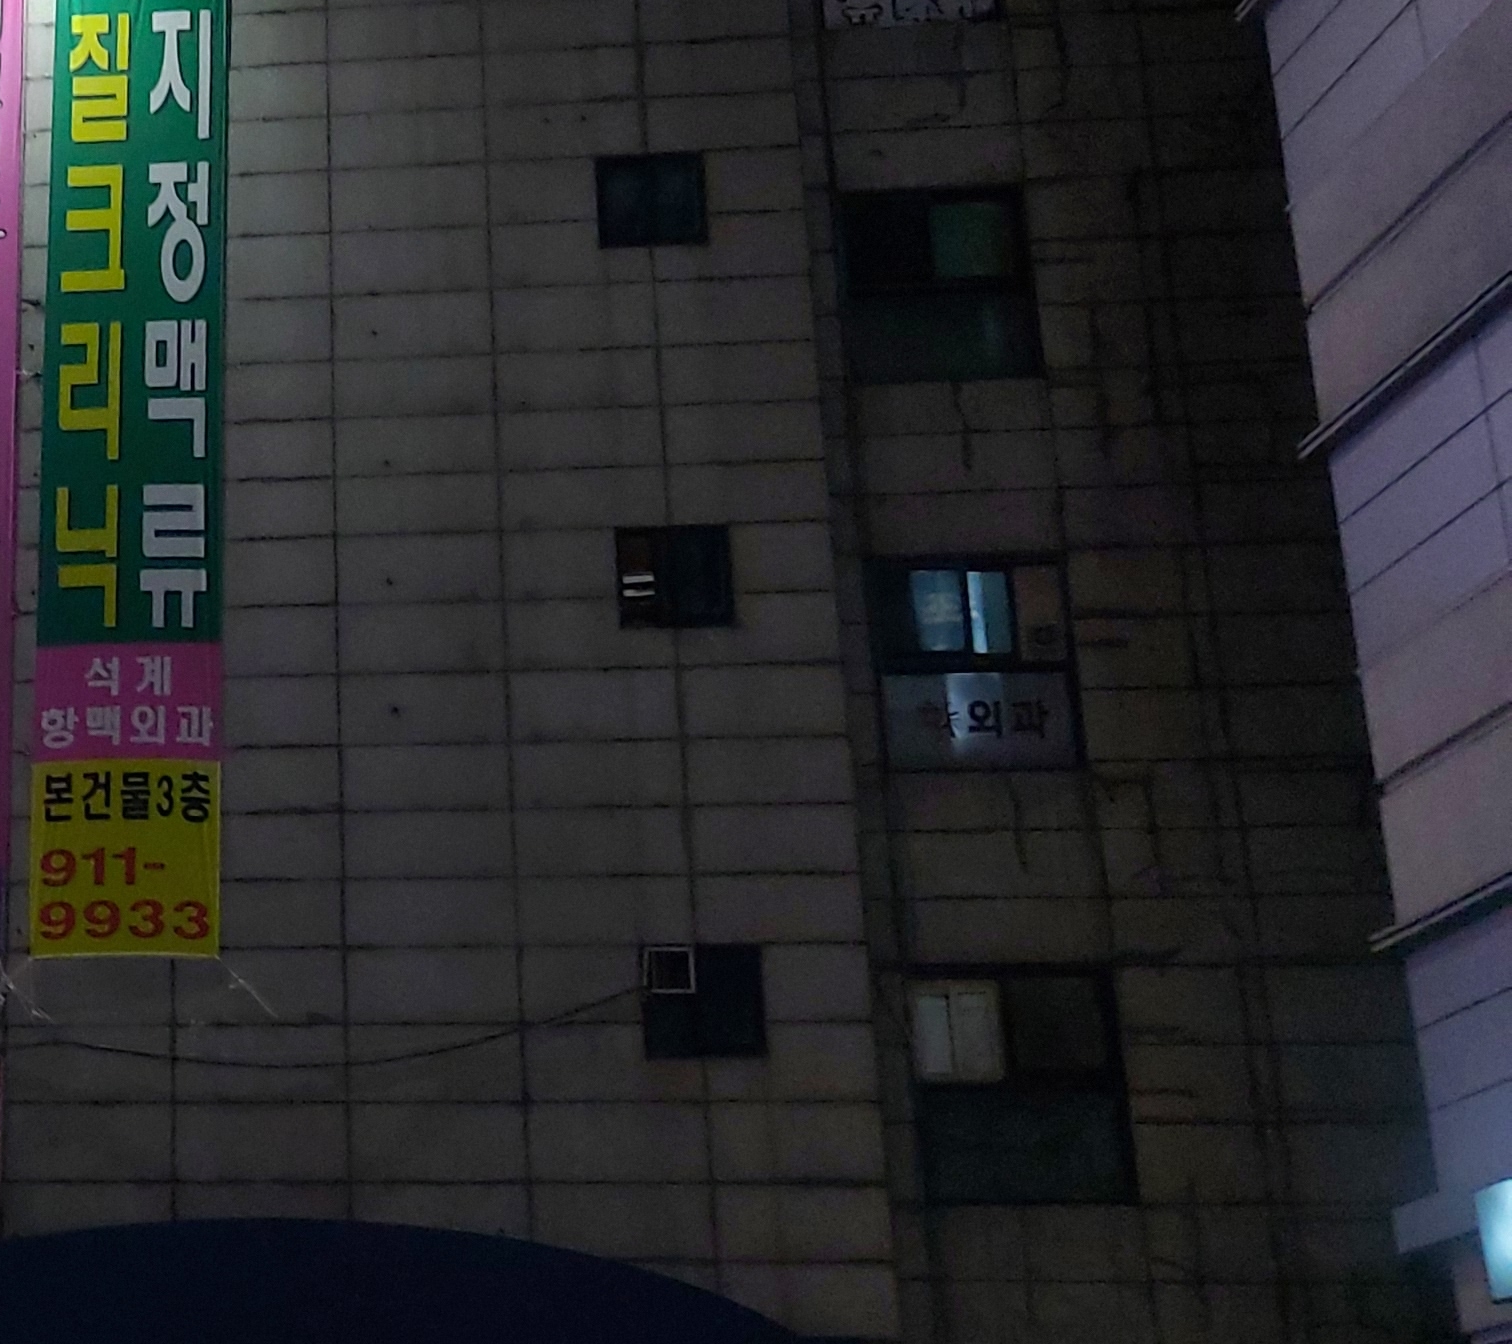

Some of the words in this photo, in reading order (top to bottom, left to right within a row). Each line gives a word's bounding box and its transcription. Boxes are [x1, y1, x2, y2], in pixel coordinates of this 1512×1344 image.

[84, 656, 171, 698] 석계
[40, 705, 213, 749] 항맥외과
[43, 770, 211, 823] 본건물3층
[40, 846, 166, 887] 911-
[40, 898, 210, 942] 9933
